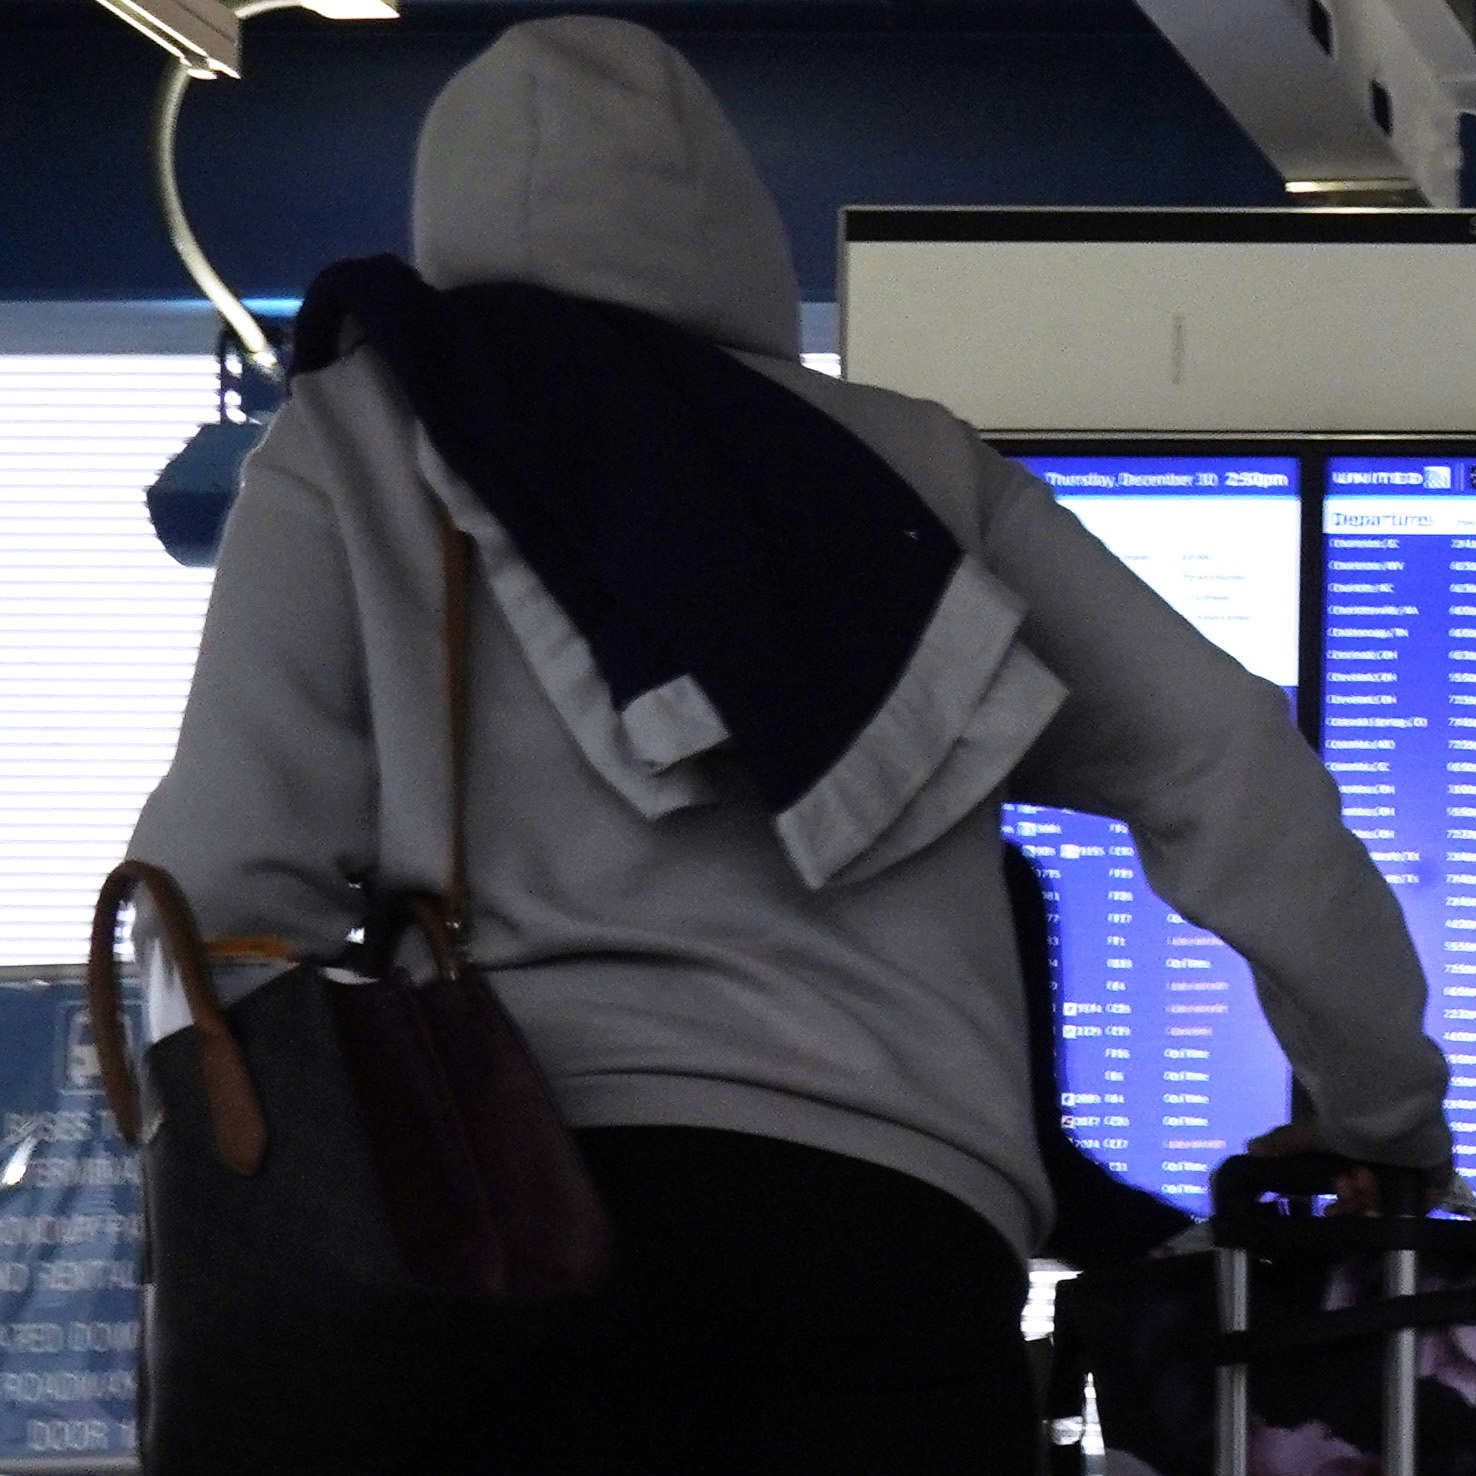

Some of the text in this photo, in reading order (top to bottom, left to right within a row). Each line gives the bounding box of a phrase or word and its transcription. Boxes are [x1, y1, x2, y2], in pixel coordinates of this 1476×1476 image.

[1119, 471, 1194, 487] December
[1333, 511, 1435, 529] Departures
[27, 1419, 109, 1452] DOOR
